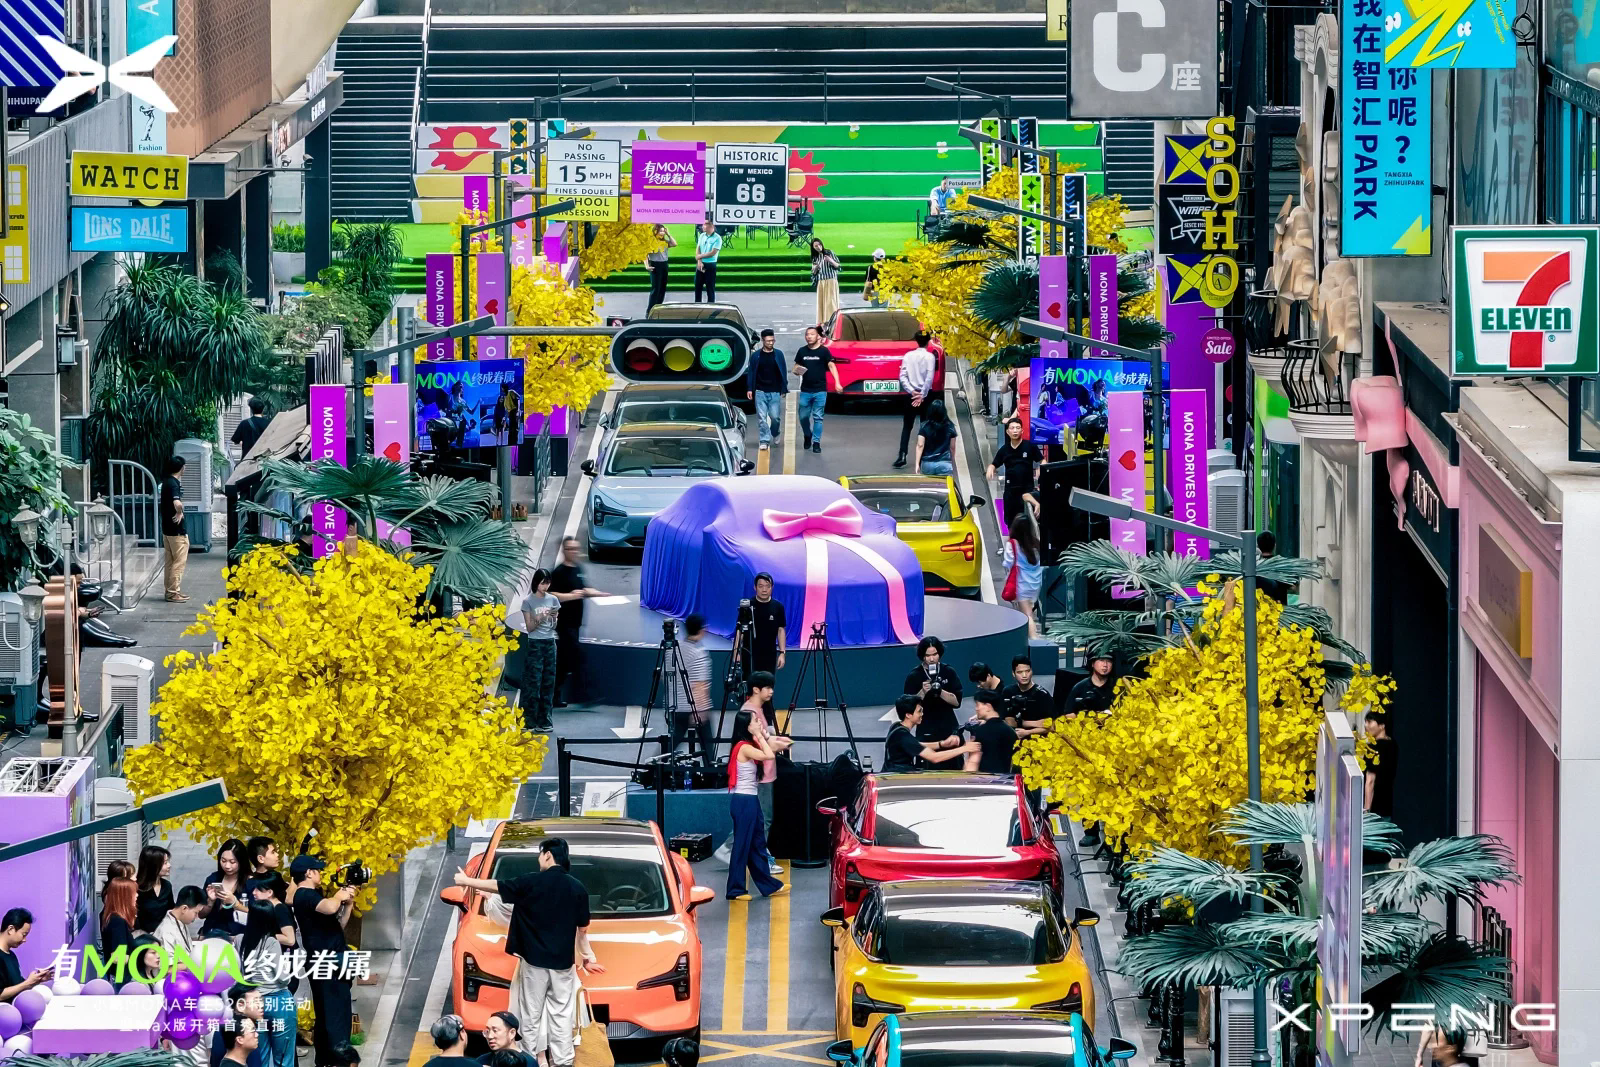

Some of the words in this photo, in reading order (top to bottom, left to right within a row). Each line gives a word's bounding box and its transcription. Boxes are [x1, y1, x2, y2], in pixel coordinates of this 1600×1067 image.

[564, 152, 606, 161] PASSING
[577, 143, 593, 151] NO
[723, 151, 779, 162] HISTORIC
[80, 164, 180, 190] WATCH
[559, 165, 587, 183] 15
[648, 173, 695, 184] 终成眷属
[1354, 135, 1378, 221] PARK
[736, 183, 766, 202] 66
[1202, 115, 1240, 296] SOHO
[723, 208, 776, 219] ROUTE
[84, 212, 122, 244] LONS
[130, 213, 174, 245] DALE
[435, 270, 445, 301] MONA
[1099, 272, 1108, 303] MONA
[1100, 306, 1109, 341] DRIVES
[1205, 340, 1233, 355] Sale
[1041, 367, 1152, 387] 有MONA终成眷
[323, 406, 334, 446] MONA
[1183, 411, 1195, 450] MONA
[1184, 454, 1196, 499] DRIVES
